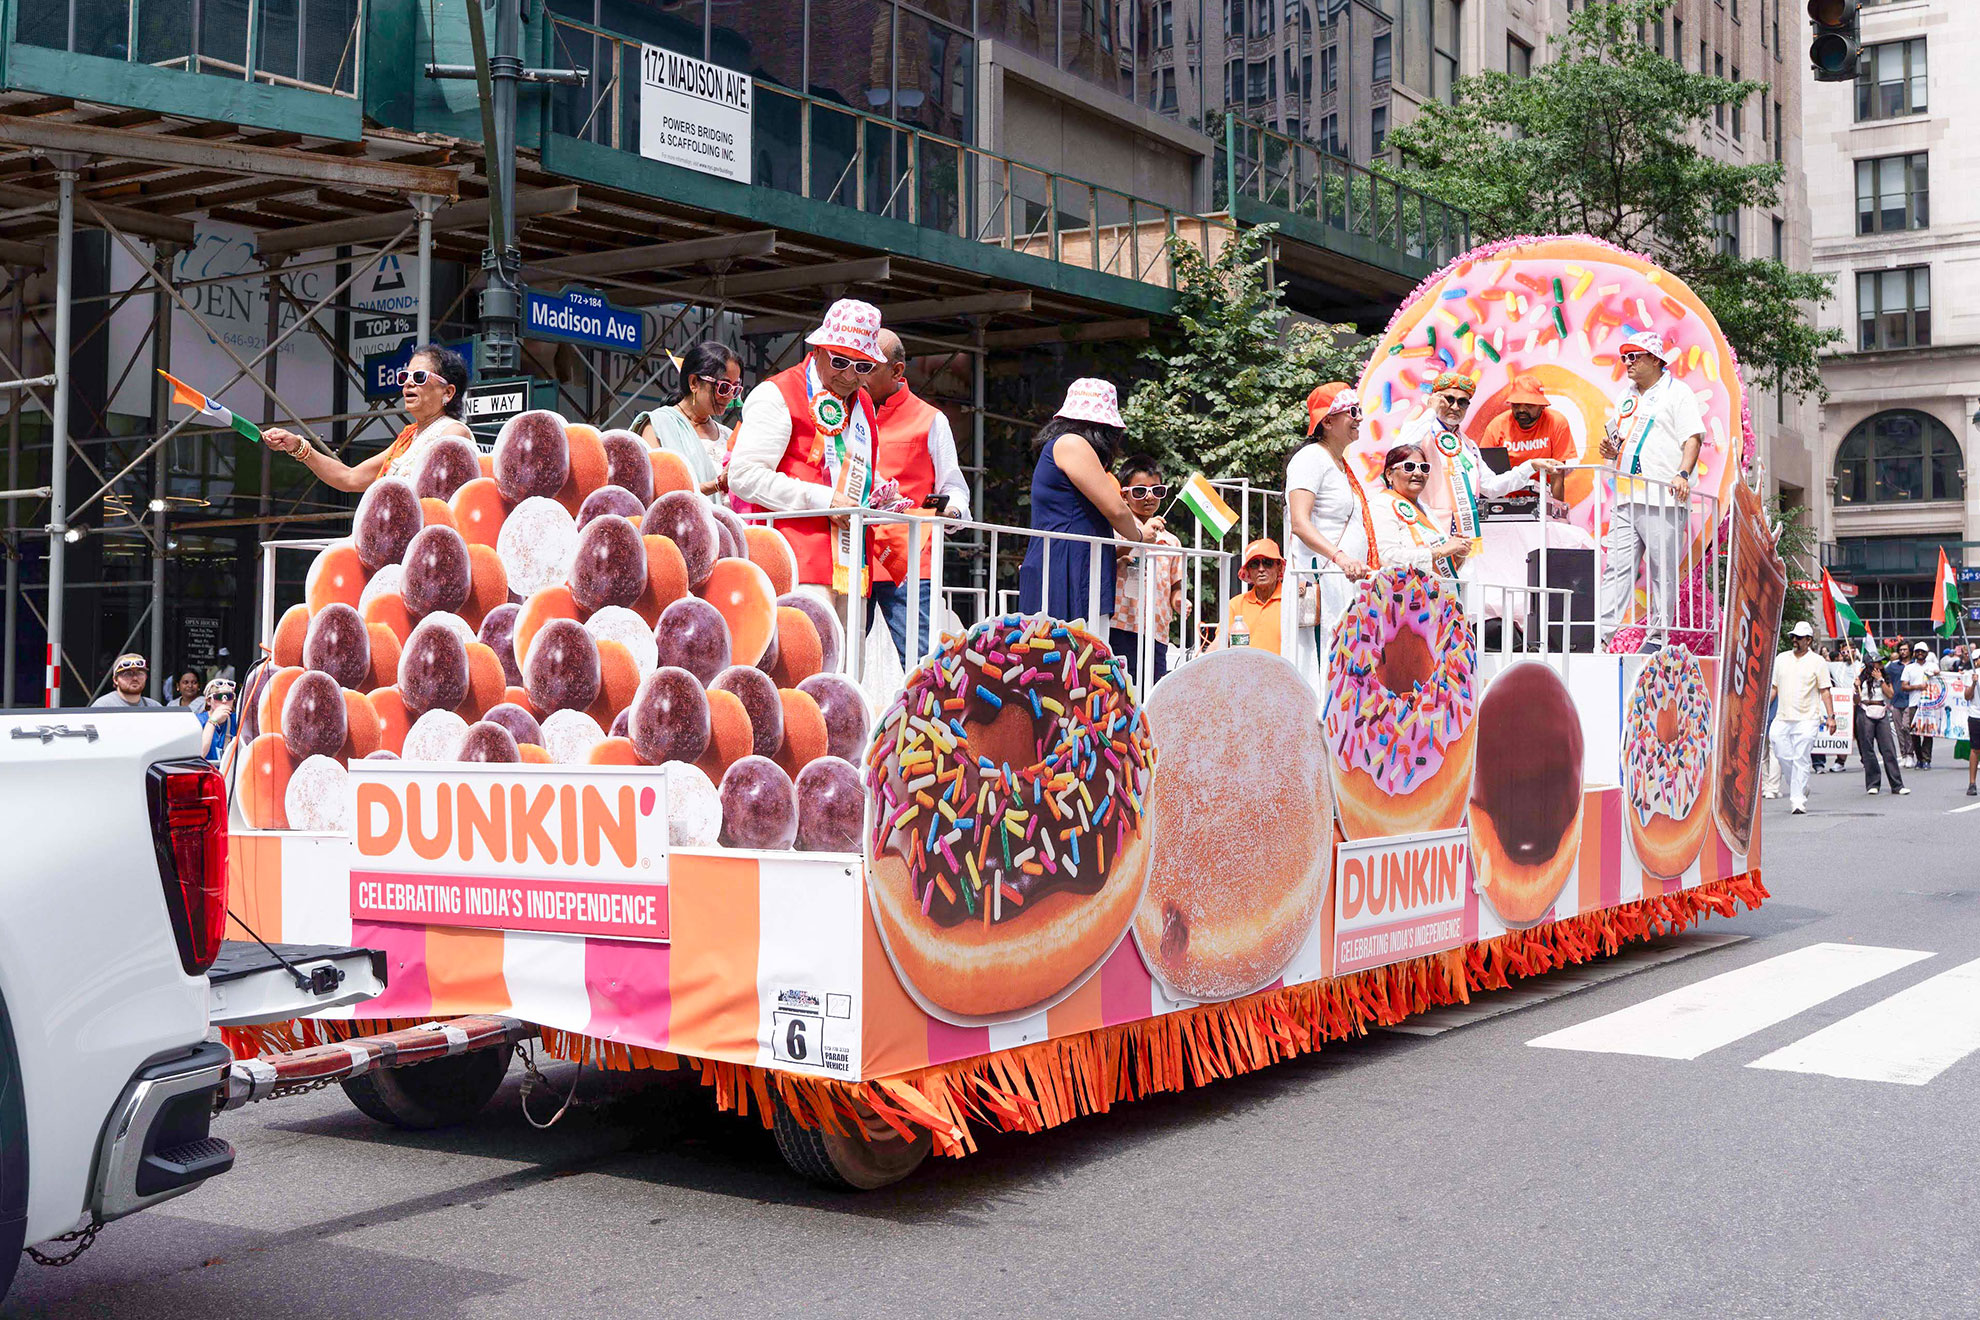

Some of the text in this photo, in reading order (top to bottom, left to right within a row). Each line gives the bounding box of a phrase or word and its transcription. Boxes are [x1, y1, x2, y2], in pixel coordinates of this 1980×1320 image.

[645, 48, 749, 110] 172 MADISON AVE.
[660, 132, 736, 162] & SCAFFOLDING INC.
[663, 116, 733, 146] POWERS BRIDGING
[180, 233, 254, 284] 172
[176, 277, 317, 334] DENAL
[532, 301, 636, 343] Madison Ave
[366, 318, 410, 336] TOP 1%
[378, 361, 408, 388] Ea
[465, 395, 515, 414] NE WAY
[1503, 437, 1549, 453] DUNKIN'
[1458, 496, 1469, 508] OF
[1734, 599, 1751, 696] ICED
[1735, 619, 1763, 806] DUNKIN'
[357, 782, 656, 868] DUNKIN'
[1342, 843, 1464, 920] DUNKIN'
[358, 881, 657, 925] CELEBRATING INDIA'S INDEPENDENCE
[1340, 918, 1461, 964] CELEBRATING INDIA'S INDEPENDENCE
[786, 1019, 807, 1060] 6
[824, 1052, 849, 1062] PARADE
[825, 1060, 850, 1071] VEHICLE
